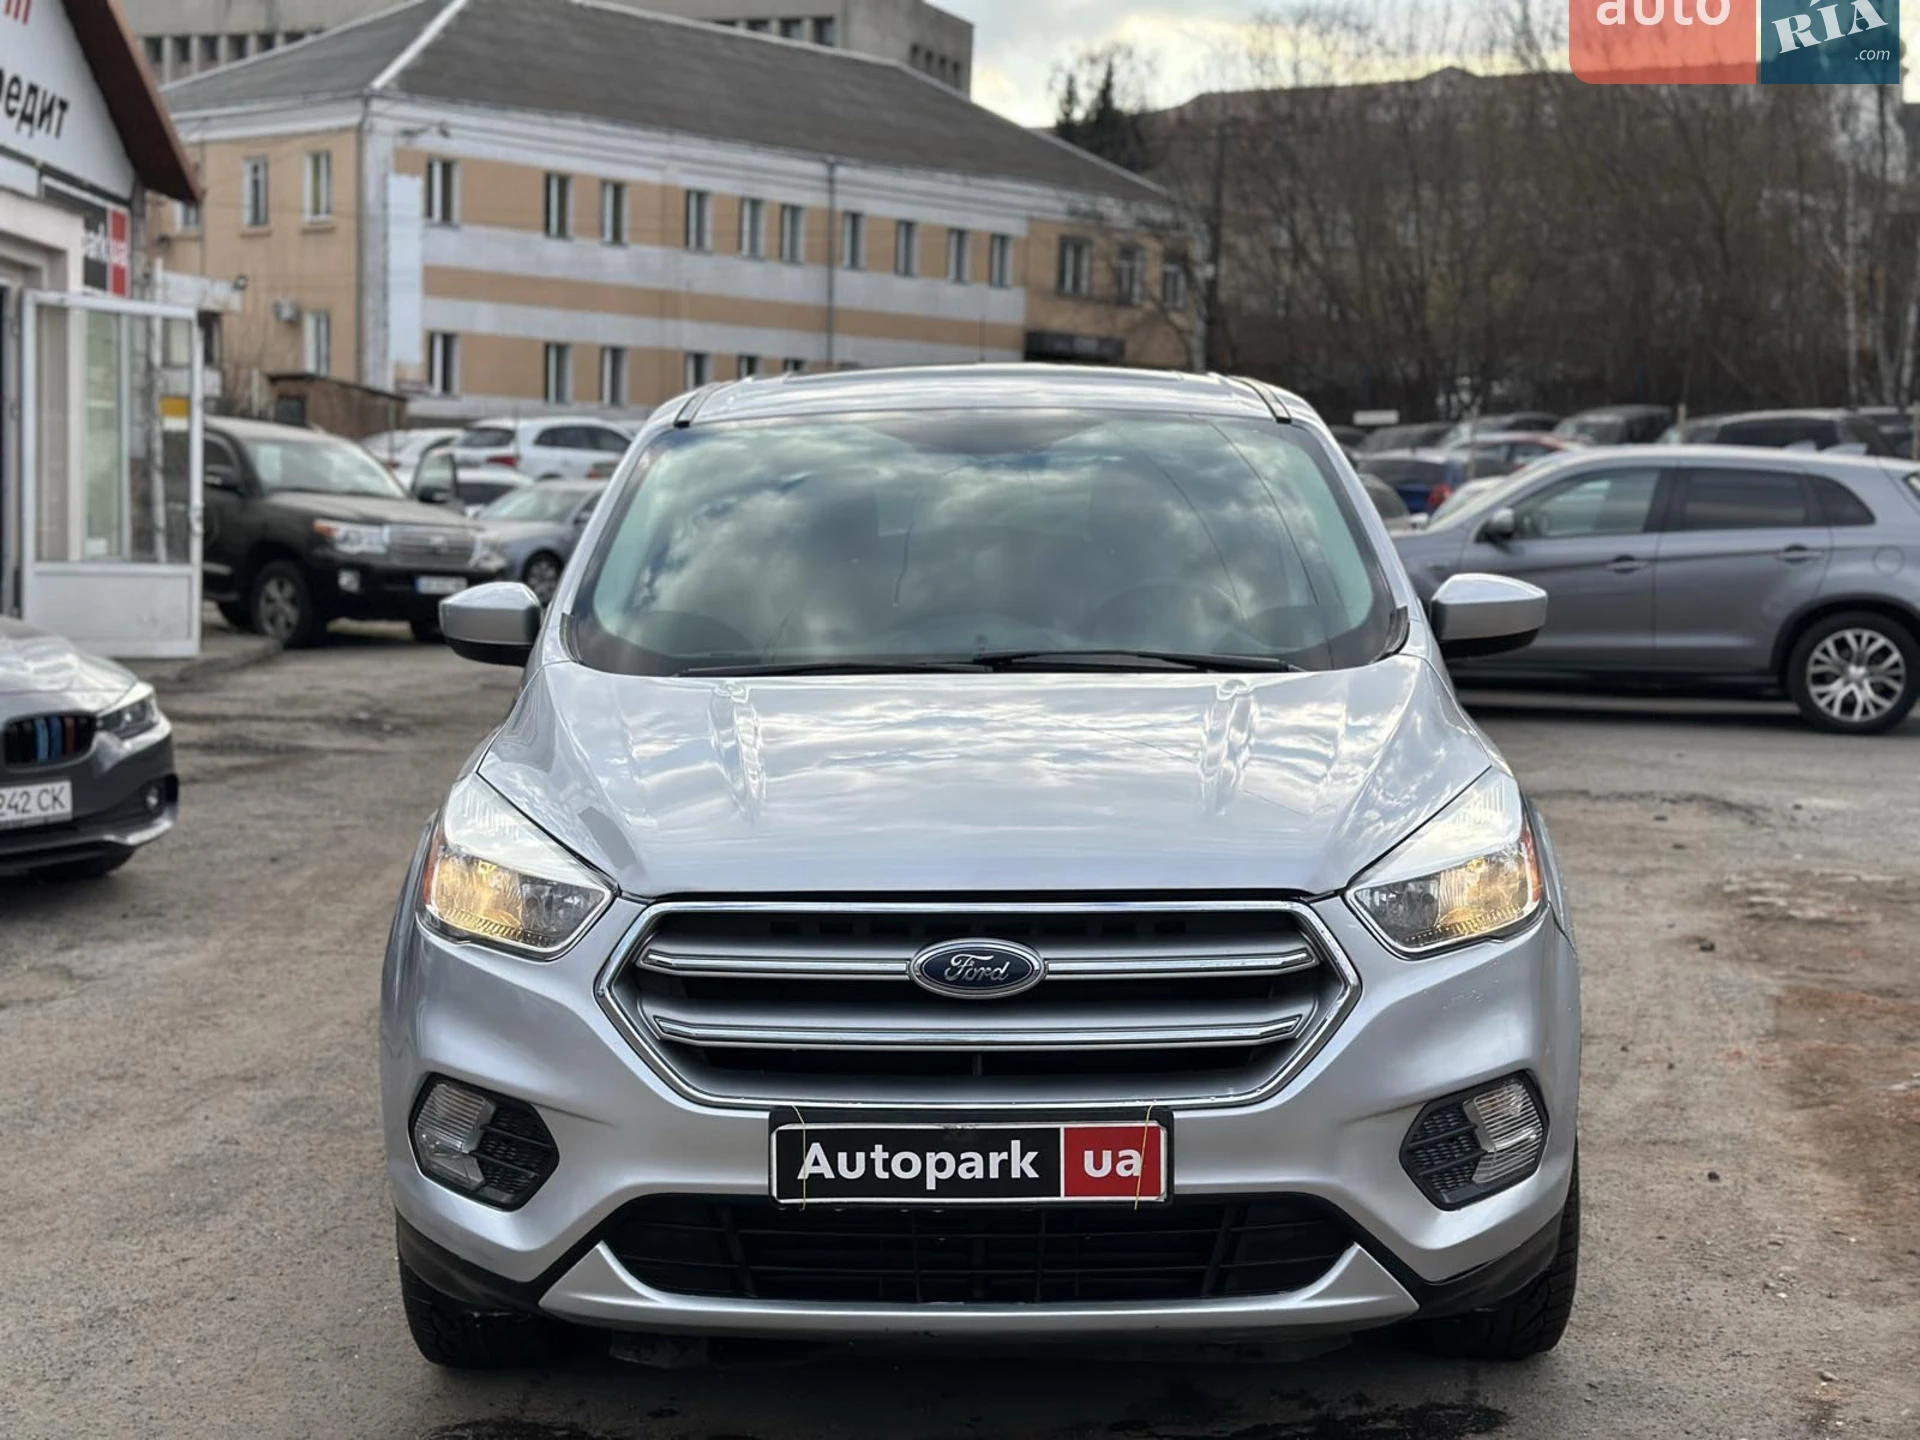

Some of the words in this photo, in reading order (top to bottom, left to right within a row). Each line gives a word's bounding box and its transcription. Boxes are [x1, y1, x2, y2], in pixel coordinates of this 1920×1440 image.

[37, 786, 66, 812] CK
[944, 953, 1011, 982] Ford
[797, 1140, 1040, 1190] Autopark
[1083, 1149, 1141, 1178] ua
